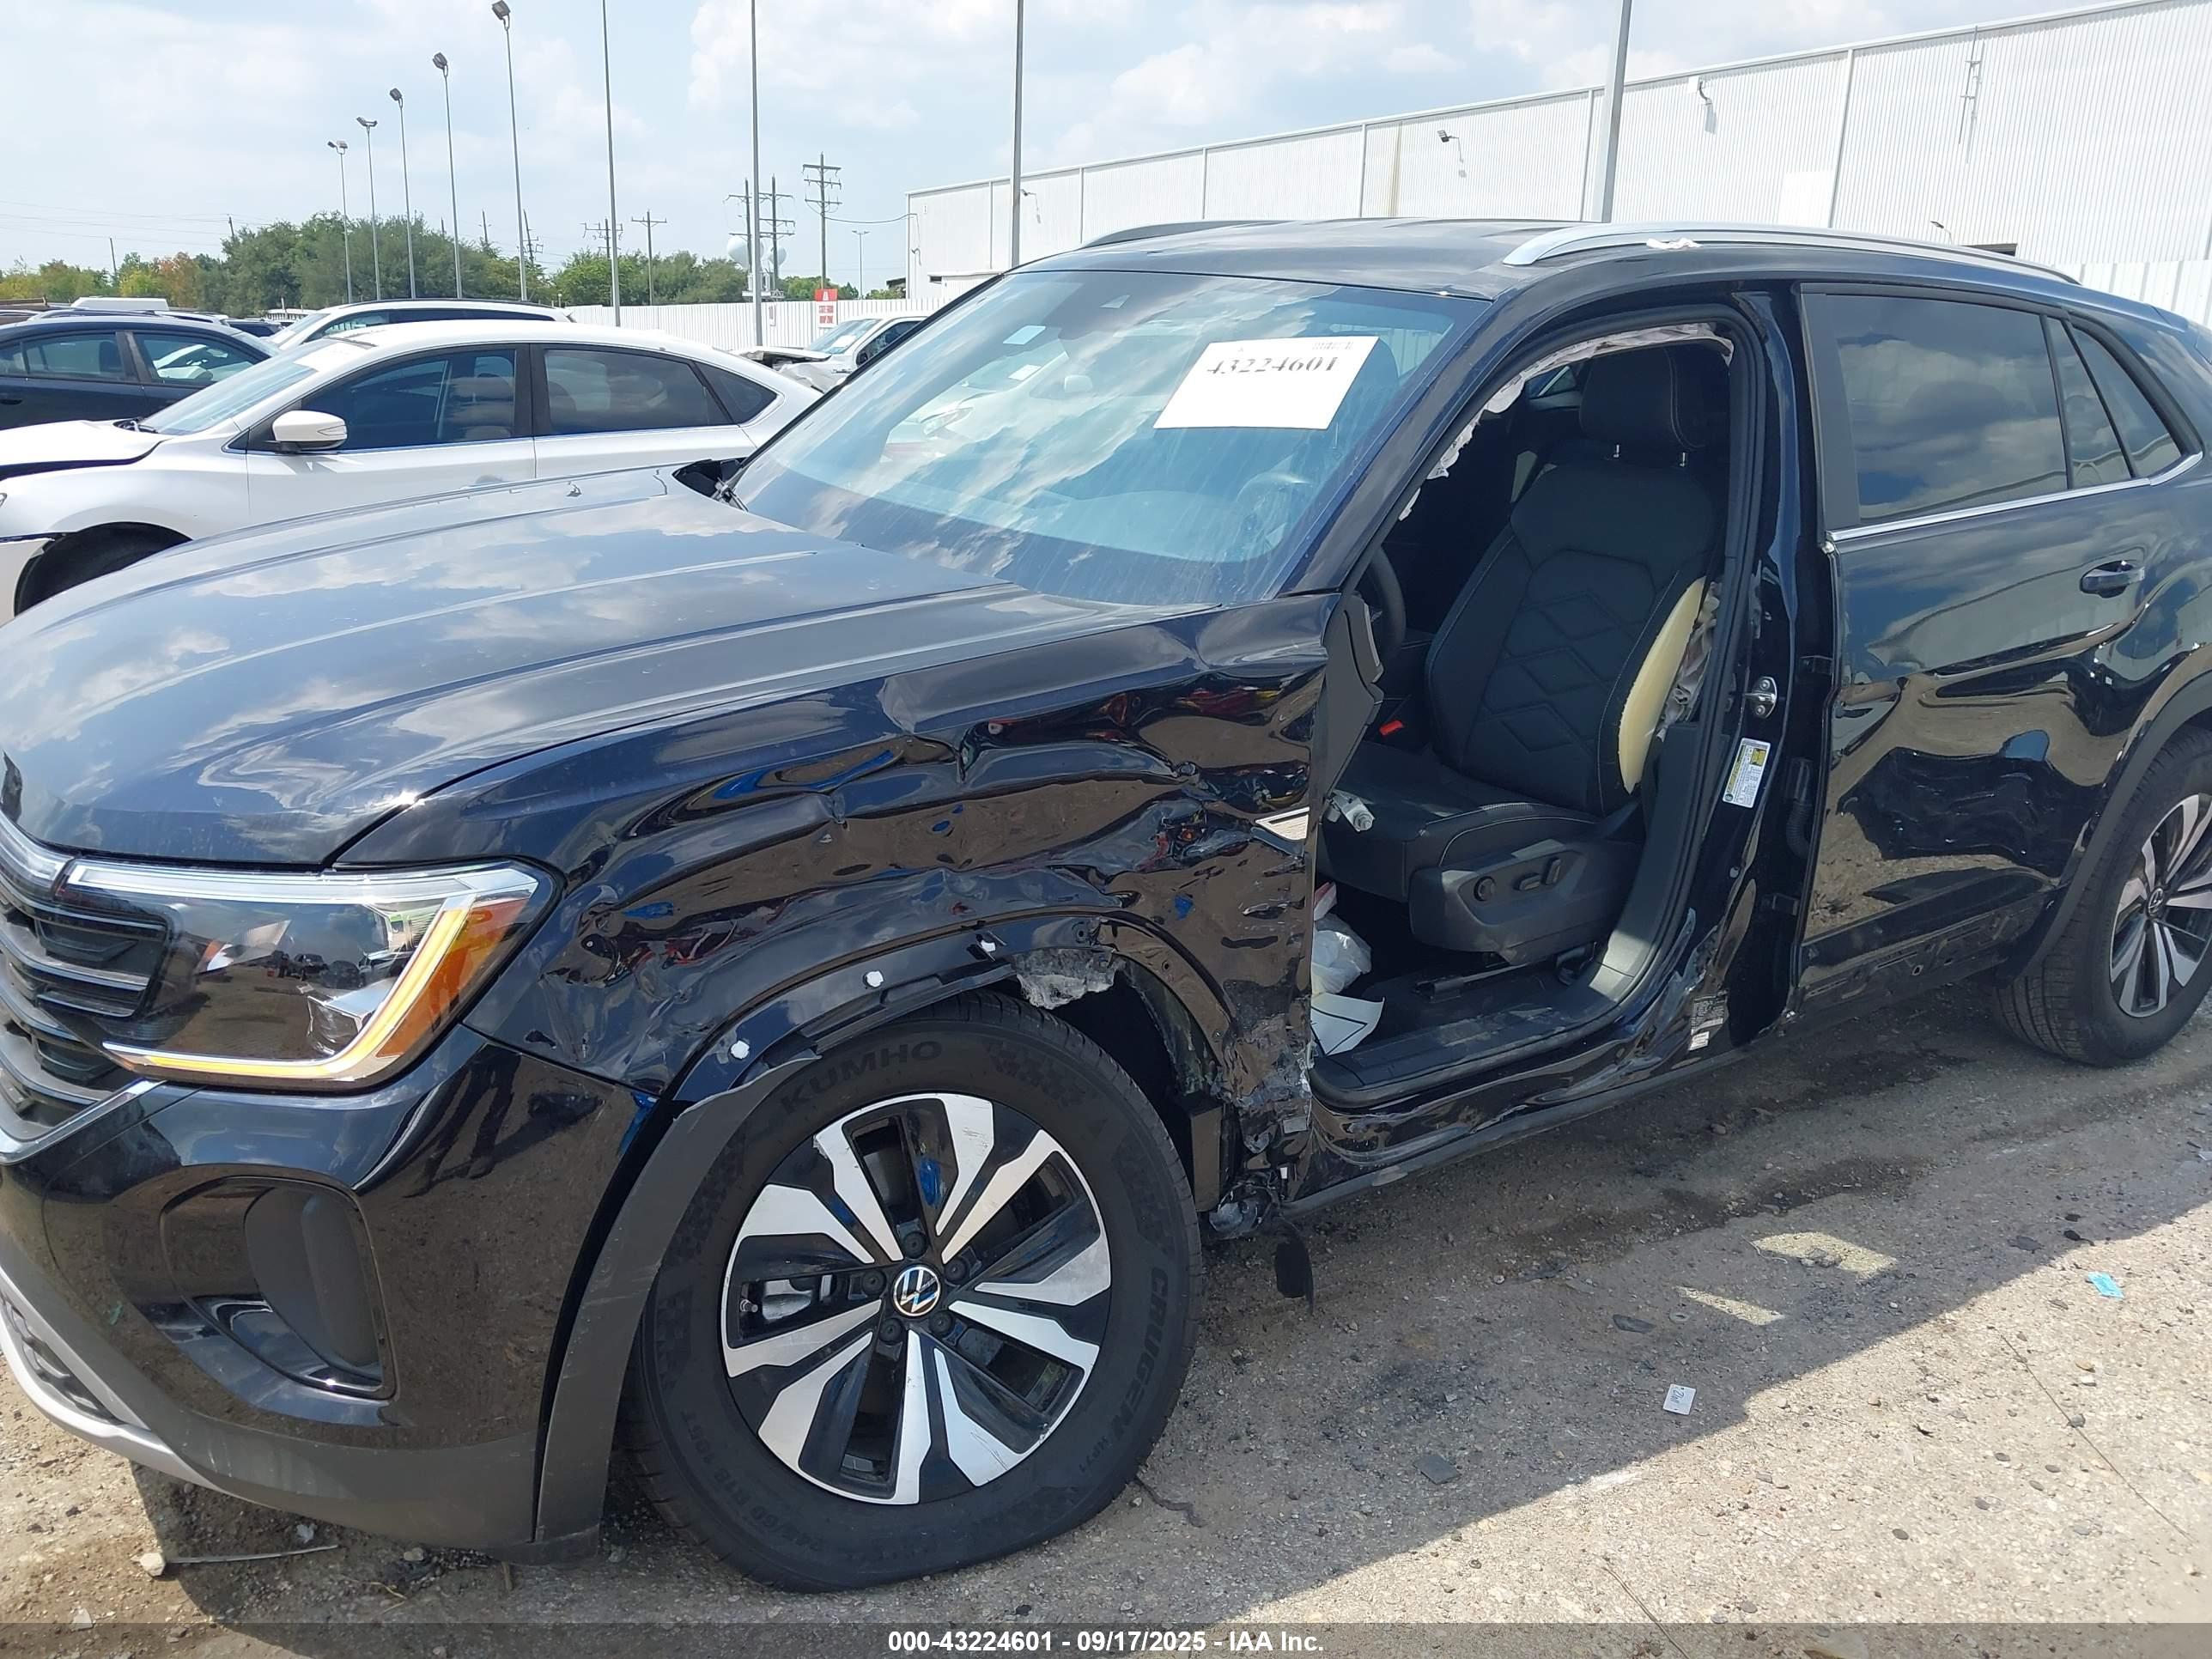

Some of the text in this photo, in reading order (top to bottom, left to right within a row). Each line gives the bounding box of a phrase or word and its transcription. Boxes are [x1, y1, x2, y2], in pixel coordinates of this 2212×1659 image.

[1206, 356, 1339, 374] 43224601
[780, 1040, 943, 1115] KUMHO
[1111, 1267, 1168, 1435] CRUGEN
